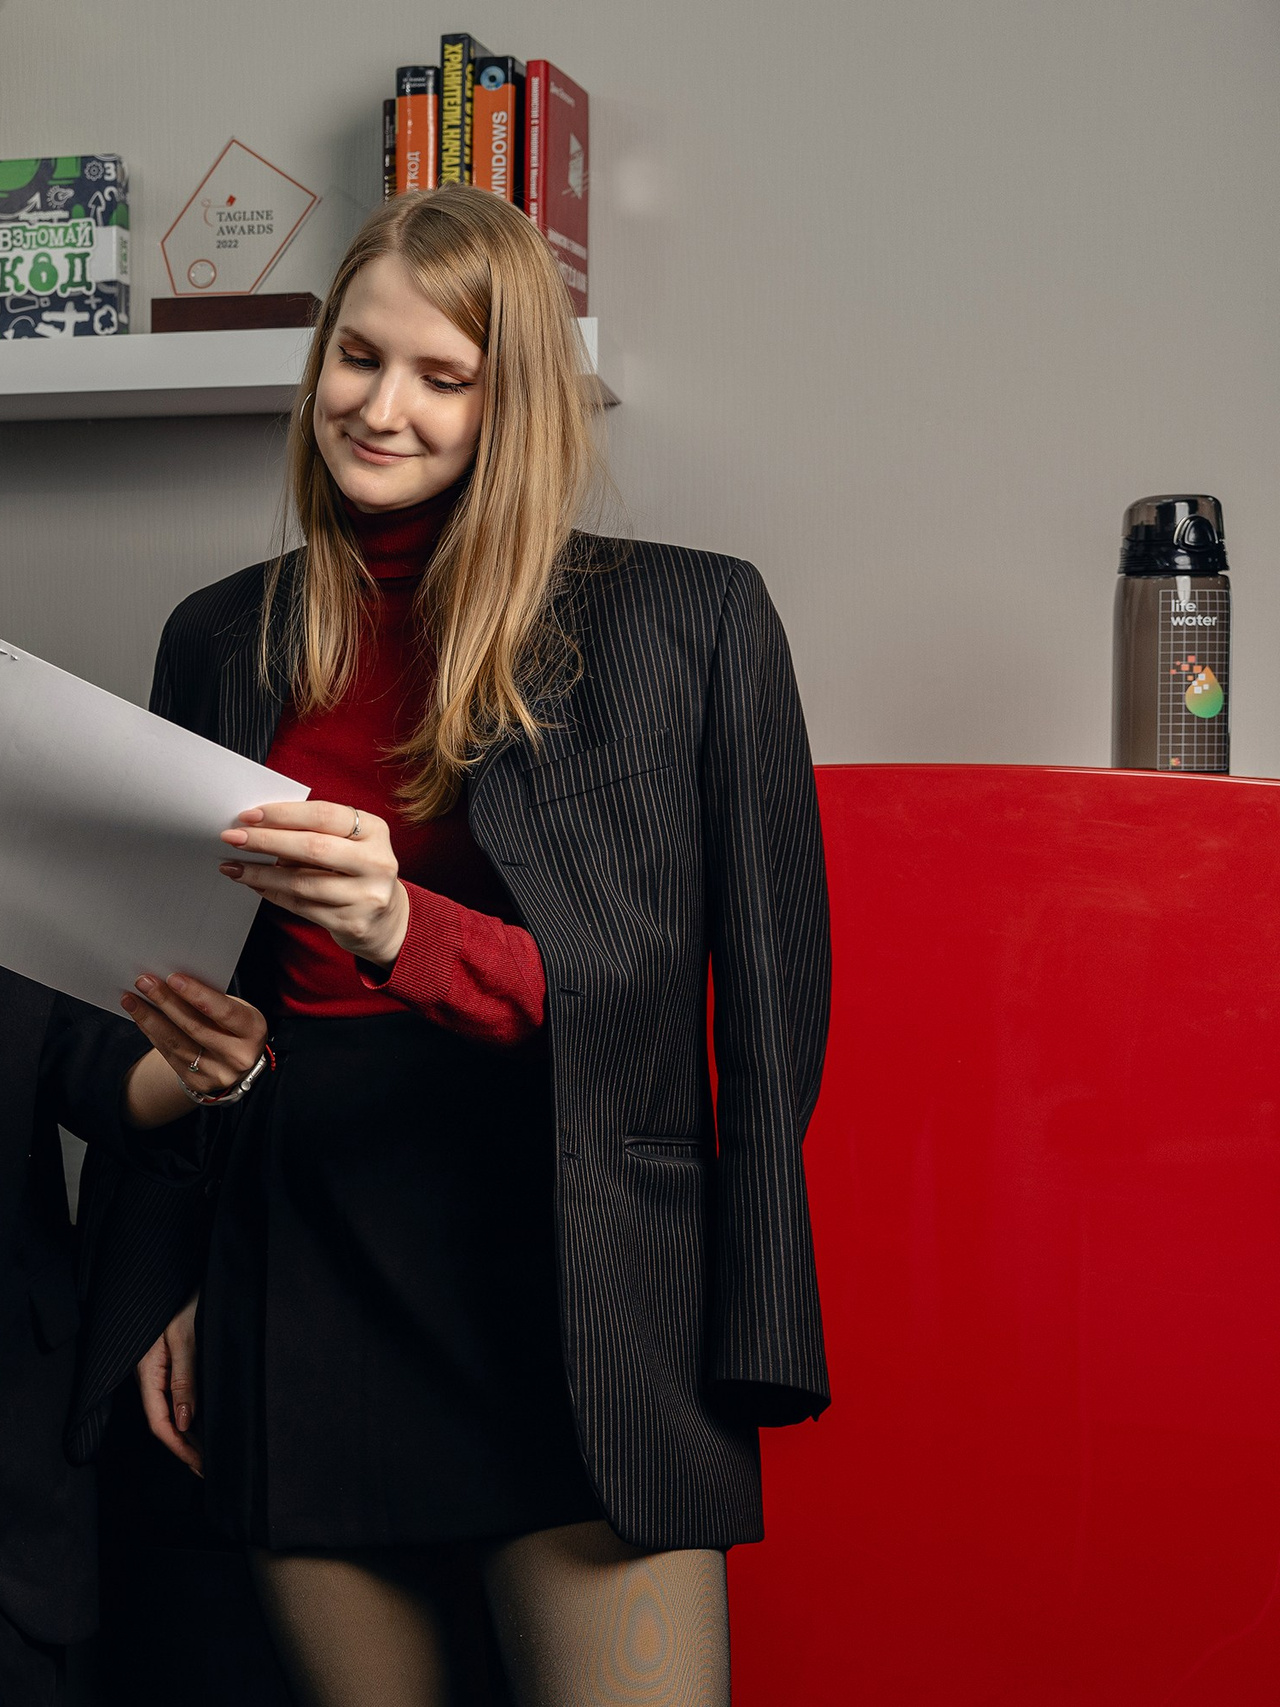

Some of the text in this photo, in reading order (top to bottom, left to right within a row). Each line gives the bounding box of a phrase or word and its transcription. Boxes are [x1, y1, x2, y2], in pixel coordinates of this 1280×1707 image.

[491, 111, 507, 199] WINDOWS
[406, 151, 421, 180] КОД
[216, 210, 274, 222] TAGLINE
[216, 224, 274, 236] AWARDS
[216, 239, 239, 249] 2022
[1171, 599, 1197, 612] life
[1171, 614, 1218, 626] water
